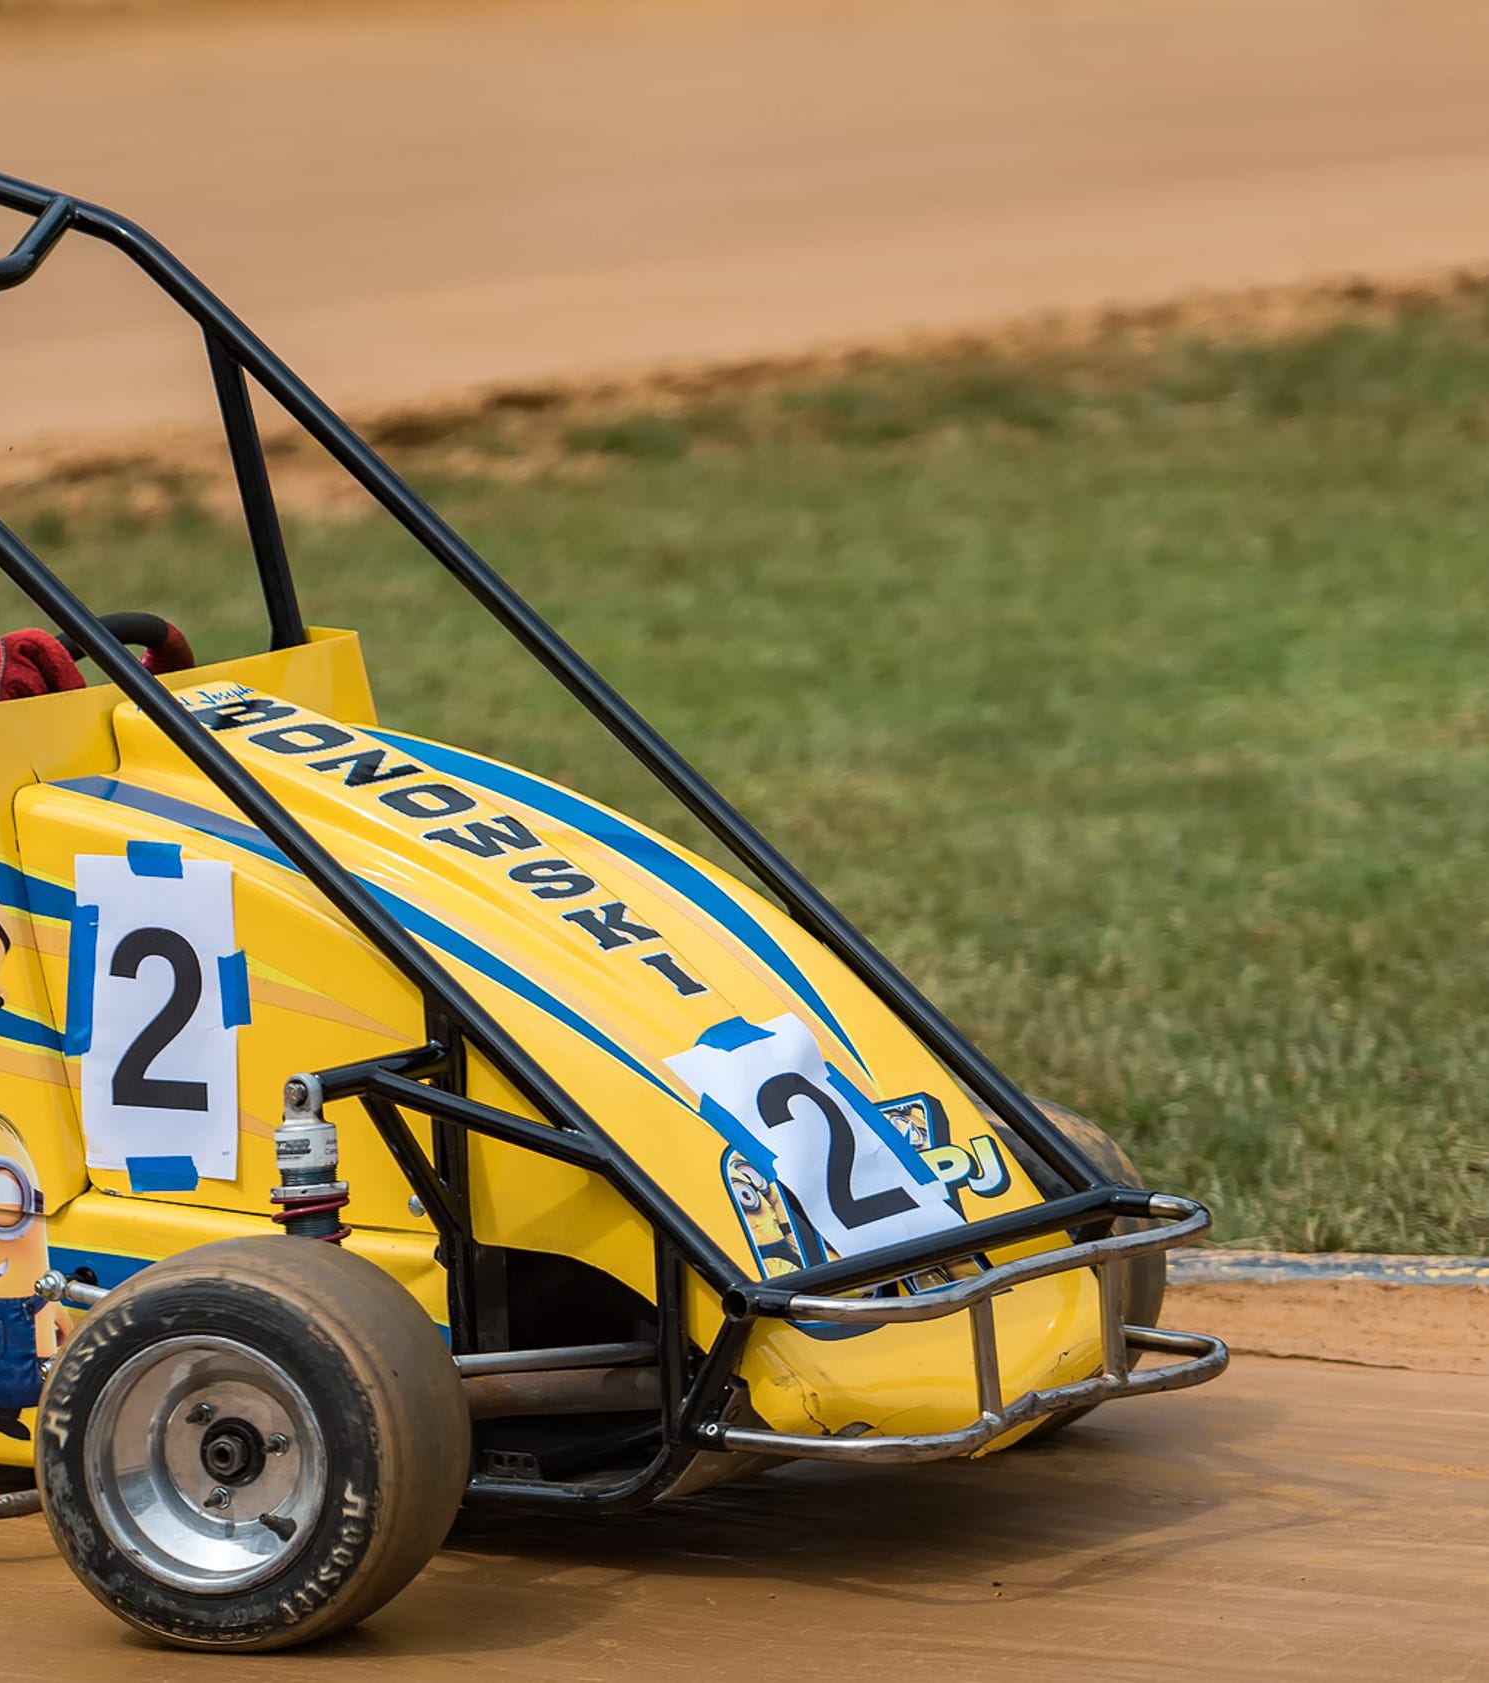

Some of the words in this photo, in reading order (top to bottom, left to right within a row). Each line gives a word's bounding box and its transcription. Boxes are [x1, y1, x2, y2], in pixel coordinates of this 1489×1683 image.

[190, 698, 710, 997] BONOWSKI
[109, 926, 209, 1112] 2
[756, 1071, 920, 1231] 2
[918, 1134, 1008, 1201] PJ
